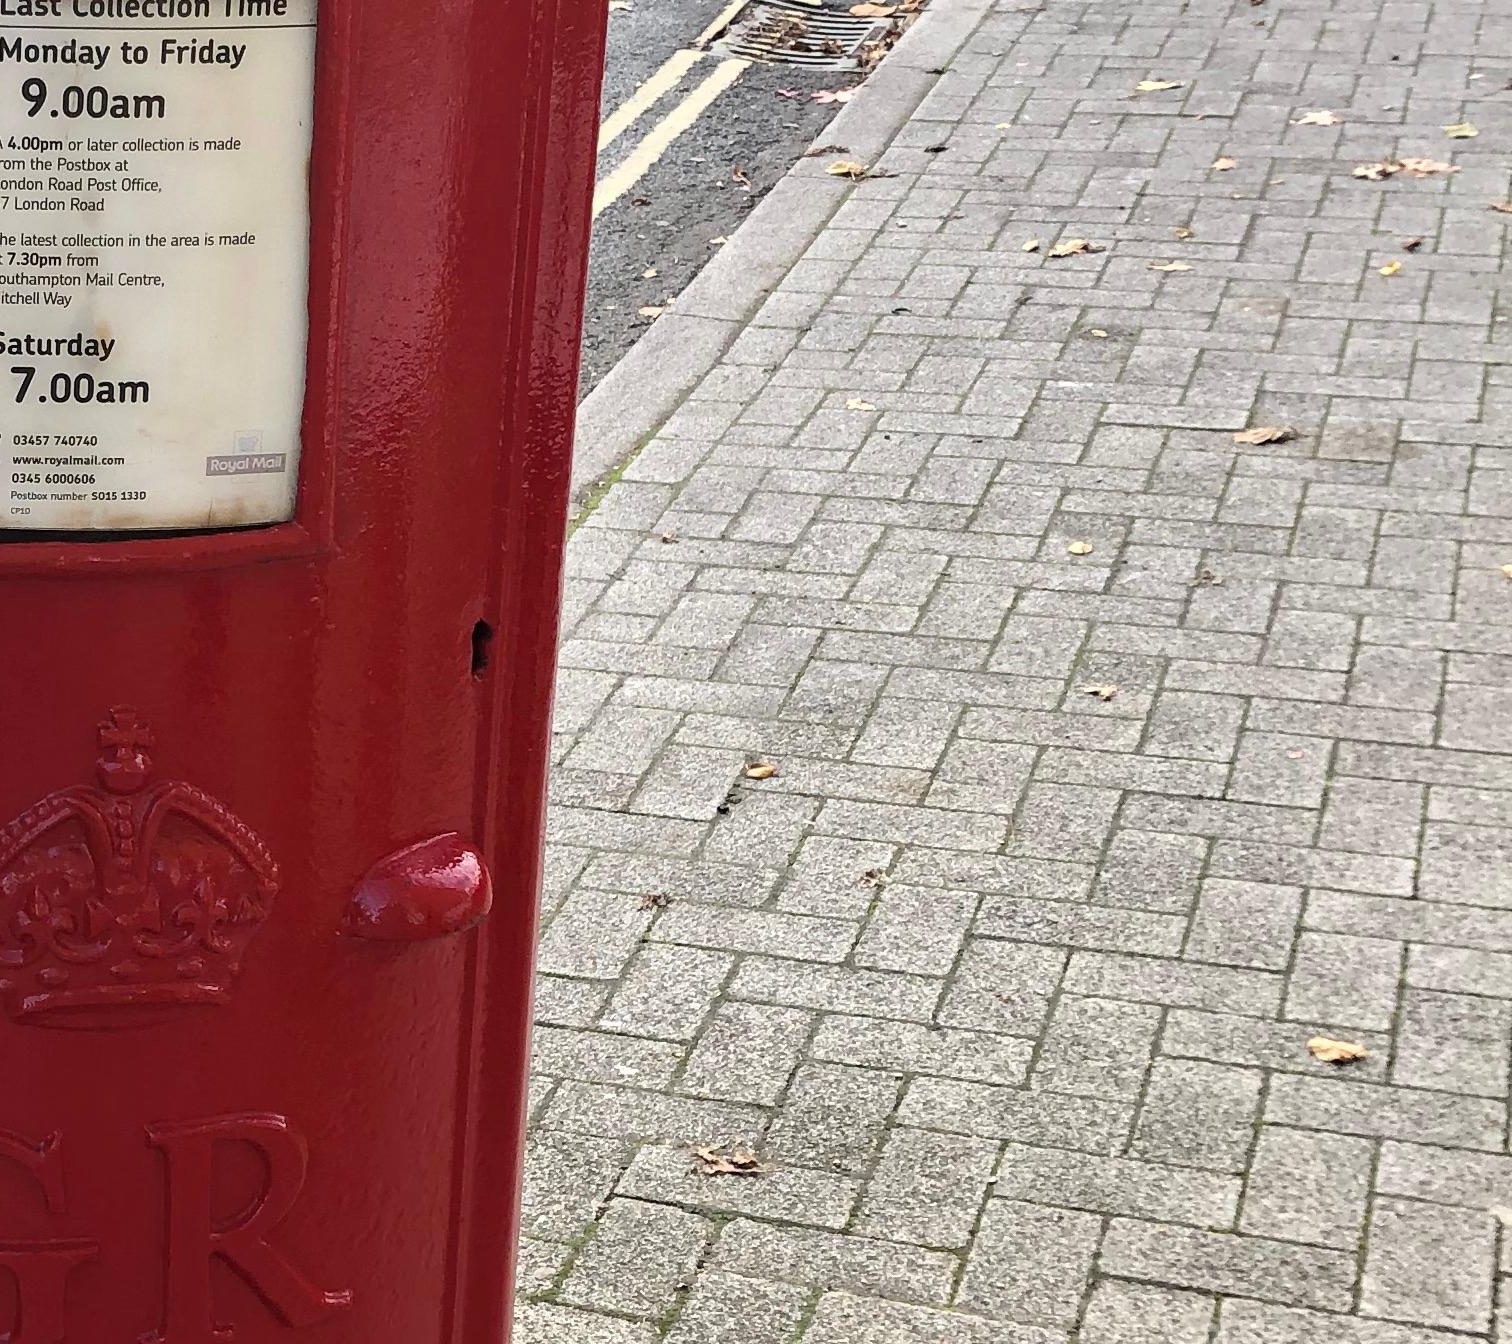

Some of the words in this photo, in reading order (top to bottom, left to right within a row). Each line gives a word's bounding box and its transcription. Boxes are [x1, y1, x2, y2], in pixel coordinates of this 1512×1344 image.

[120, 41, 149, 65] to
[160, 38, 247, 70] Friday
[21, 77, 166, 119] 9.00am
[7, 135, 63, 154] 4.00pm
[67, 140, 84, 152] or
[86, 137, 119, 152] later
[121, 137, 185, 152] collection
[188, 138, 200, 152] is
[203, 136, 242, 151] made
[29, 157, 53, 171] the
[57, 157, 112, 172] Postbox
[114, 159, 129, 172] at
[48, 176, 83, 192] Road
[87, 177, 118, 192] Post
[121, 177, 162, 193] Office,
[14, 196, 66, 211] London
[70, 197, 105, 212] Road
[20, 232, 58, 247] latest
[61, 233, 124, 248] collection
[128, 233, 141, 247] in
[145, 233, 167, 247] the
[170, 236, 200, 247] area
[204, 232, 215, 247] is
[218, 231, 256, 246] made
[6, 251, 62, 269] 7.30pm
[66, 253, 99, 267] from
[85, 272, 114, 287] Mail
[117, 272, 165, 288] Centre,
[42, 291, 73, 309] Way
[10, 366, 150, 404] 7.00am
[12, 434, 50, 446] 03457
[53, 435, 98, 447] 740740
[12, 454, 125, 468] www.royalmail.com
[210, 458, 249, 472] Royal
[252, 456, 282, 468] Mail
[11, 472, 41, 484] 0345
[44, 473, 96, 485] 6000606
[10, 490, 48, 501] Postbox
[50, 492, 89, 501] number
[120, 490, 147, 501] 133D
